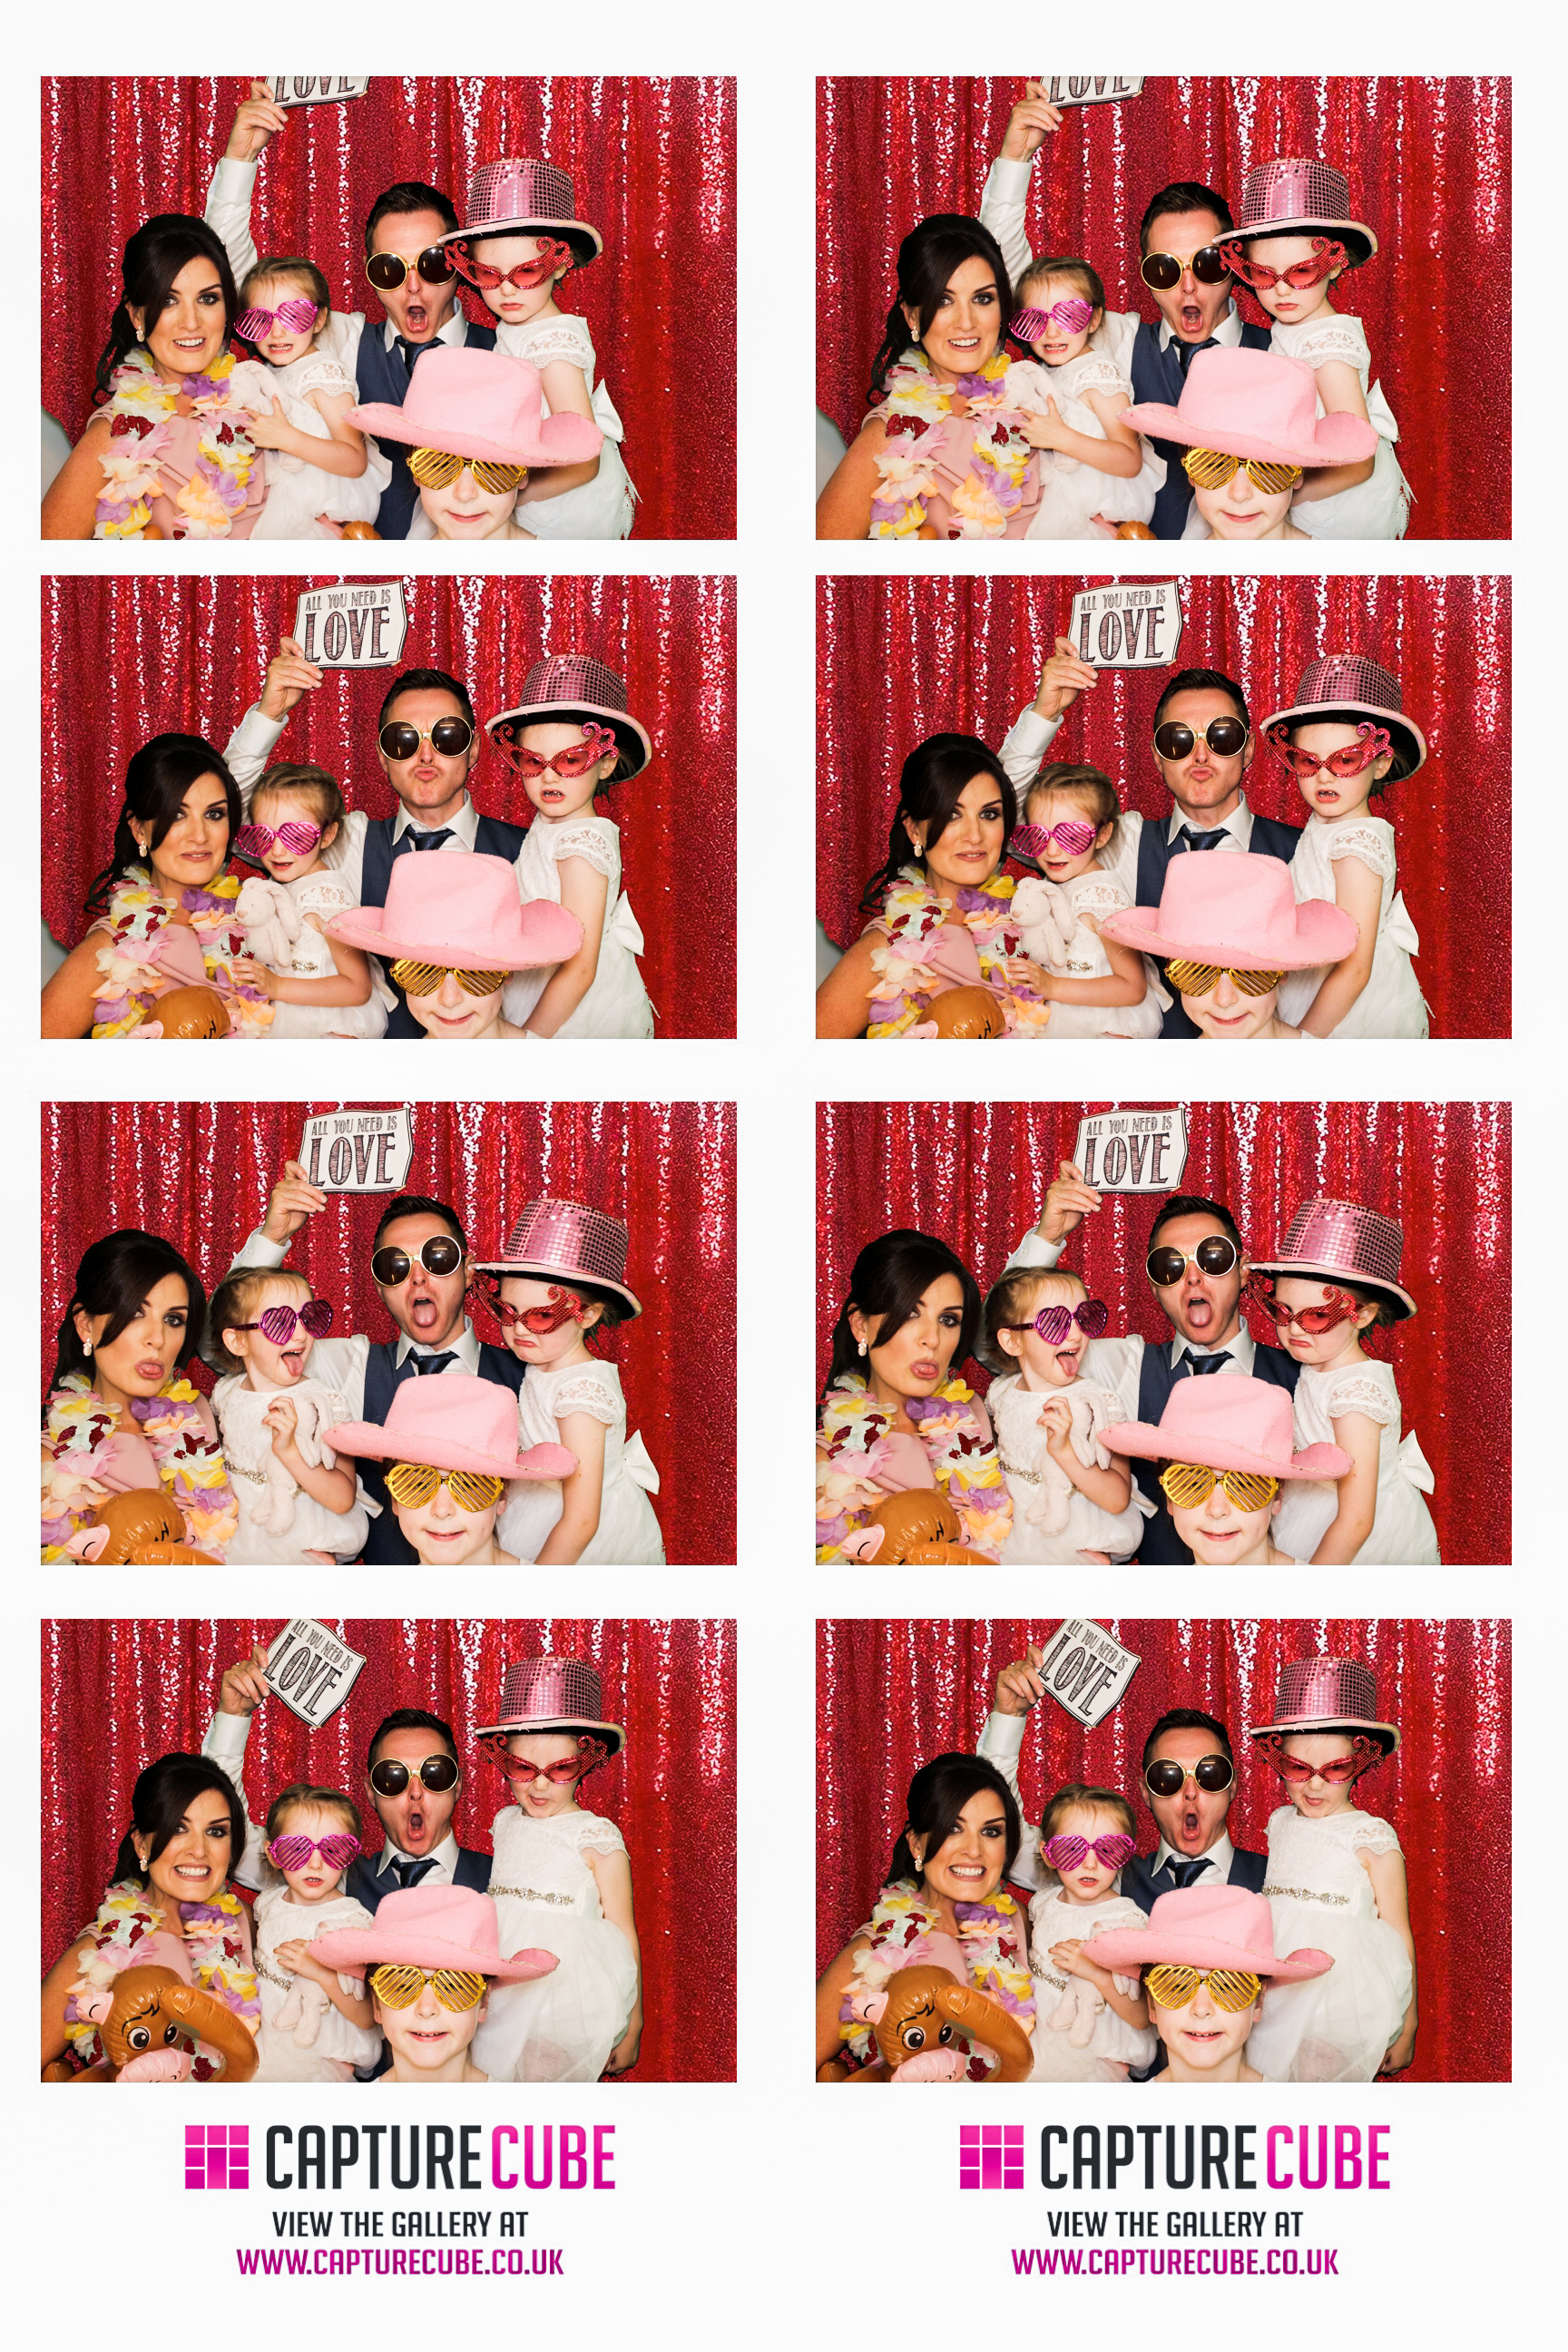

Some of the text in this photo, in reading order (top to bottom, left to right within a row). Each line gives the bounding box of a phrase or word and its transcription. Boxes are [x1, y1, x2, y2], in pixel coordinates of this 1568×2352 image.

[305, 589, 391, 612] ALL YOU NEED IS
[1080, 589, 1166, 612] ALL YOU NEED IS
[304, 606, 390, 663] LOVE
[1079, 606, 1165, 663] LOVE
[311, 1115, 397, 1136] ALL YOU NEED IS
[1086, 1115, 1172, 1136] ALL YOU NEED IS
[309, 1132, 396, 1188] LOVE
[1083, 1132, 1171, 1188] LOVE
[290, 1619, 354, 1671] ALL YOU NEED IS
[1065, 1619, 1129, 1671] ALL YOU NEED IS
[262, 1632, 343, 1717] LOVE
[1037, 1632, 1118, 1717] LOVE
